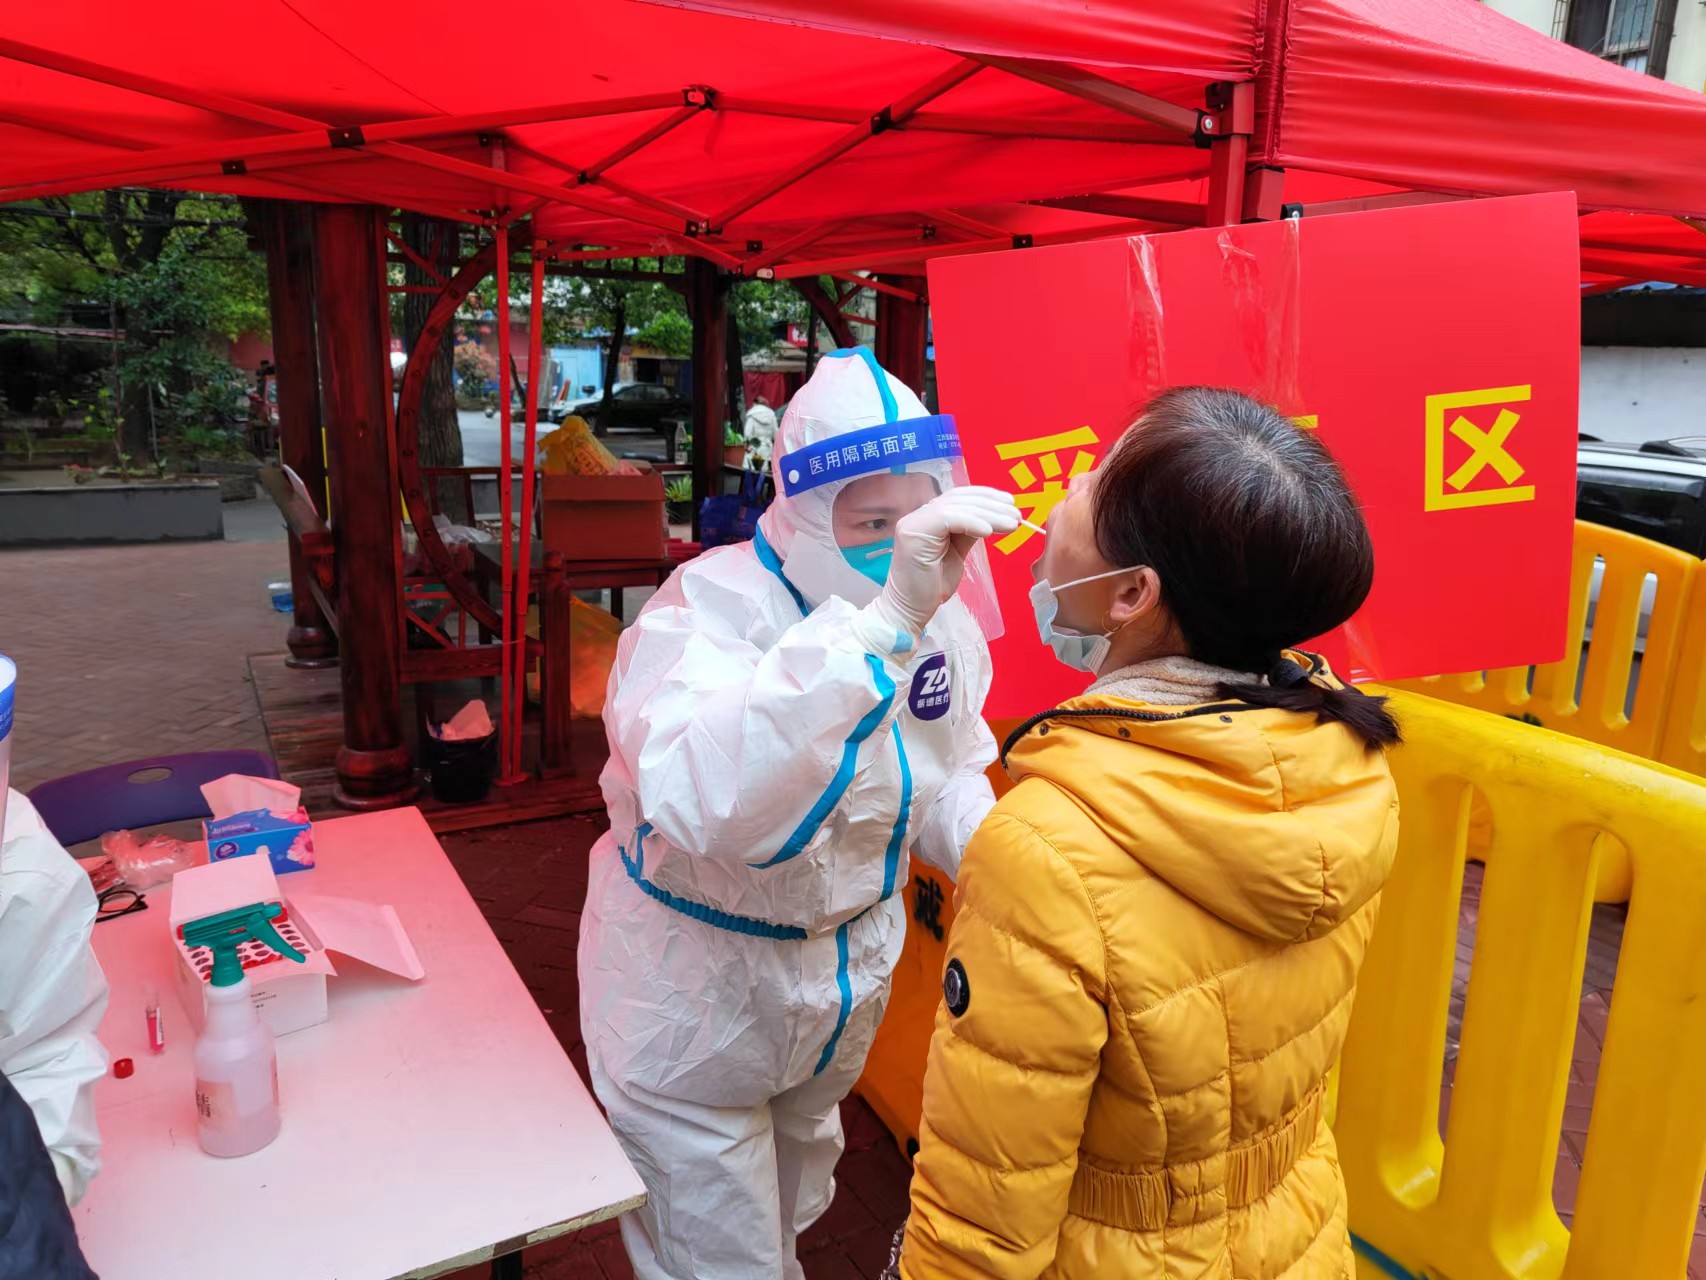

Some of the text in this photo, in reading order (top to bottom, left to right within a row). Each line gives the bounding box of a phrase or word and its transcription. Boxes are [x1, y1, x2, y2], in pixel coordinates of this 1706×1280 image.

[809, 431, 920, 475] 医用隔离面罩
[994, 384, 1536, 556] 采区
[920, 665, 948, 695] ZD
